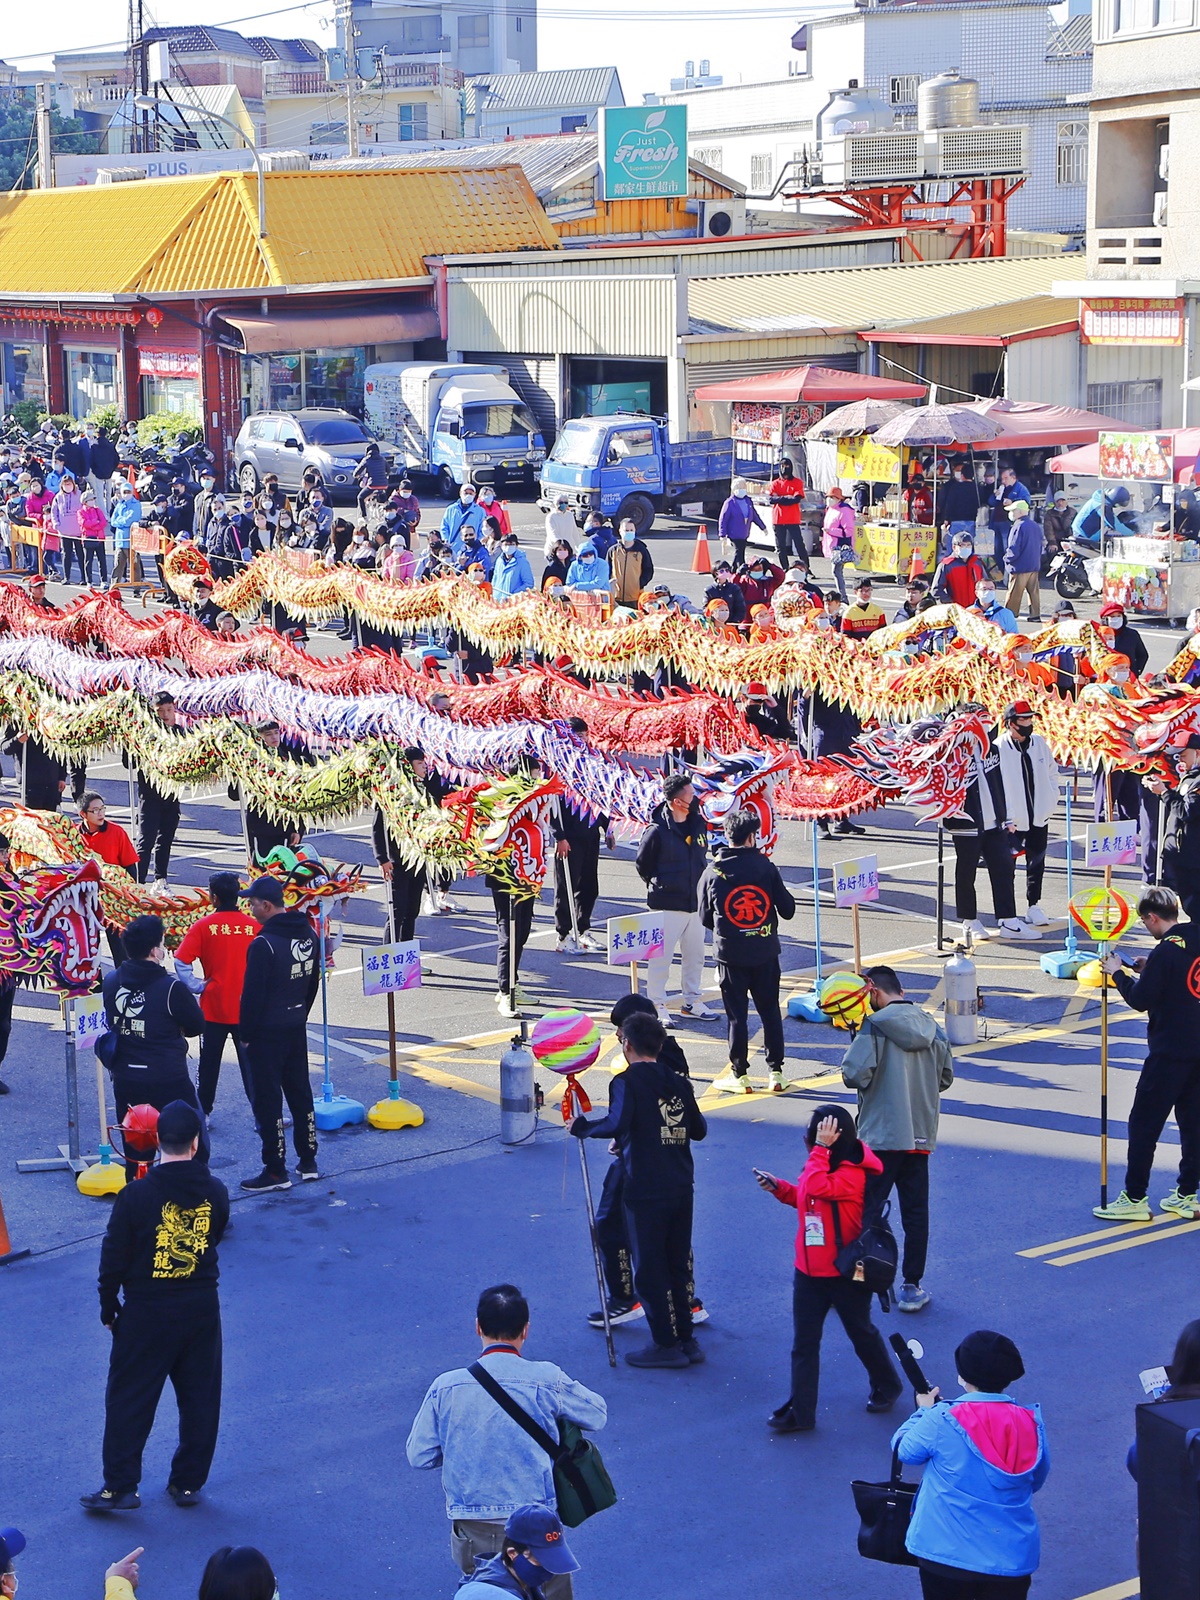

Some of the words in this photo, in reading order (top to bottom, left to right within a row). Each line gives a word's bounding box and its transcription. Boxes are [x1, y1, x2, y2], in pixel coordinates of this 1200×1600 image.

[637, 137, 657, 146] Just
[613, 143, 679, 163] Fresh
[147, 162, 188, 177] PLUS
[614, 180, 679, 195] 鄰家生鮮超市
[903, 531, 934, 542] 大熱狗
[1090, 835, 1136, 853] 三義龍藝
[836, 871, 878, 891] 尚好龍藝
[208, 923, 255, 936] 寶德工程
[612, 928, 663, 950] 禾豐龍藝
[290, 972, 304, 980] XING
[379, 971, 407, 989] 龍藝
